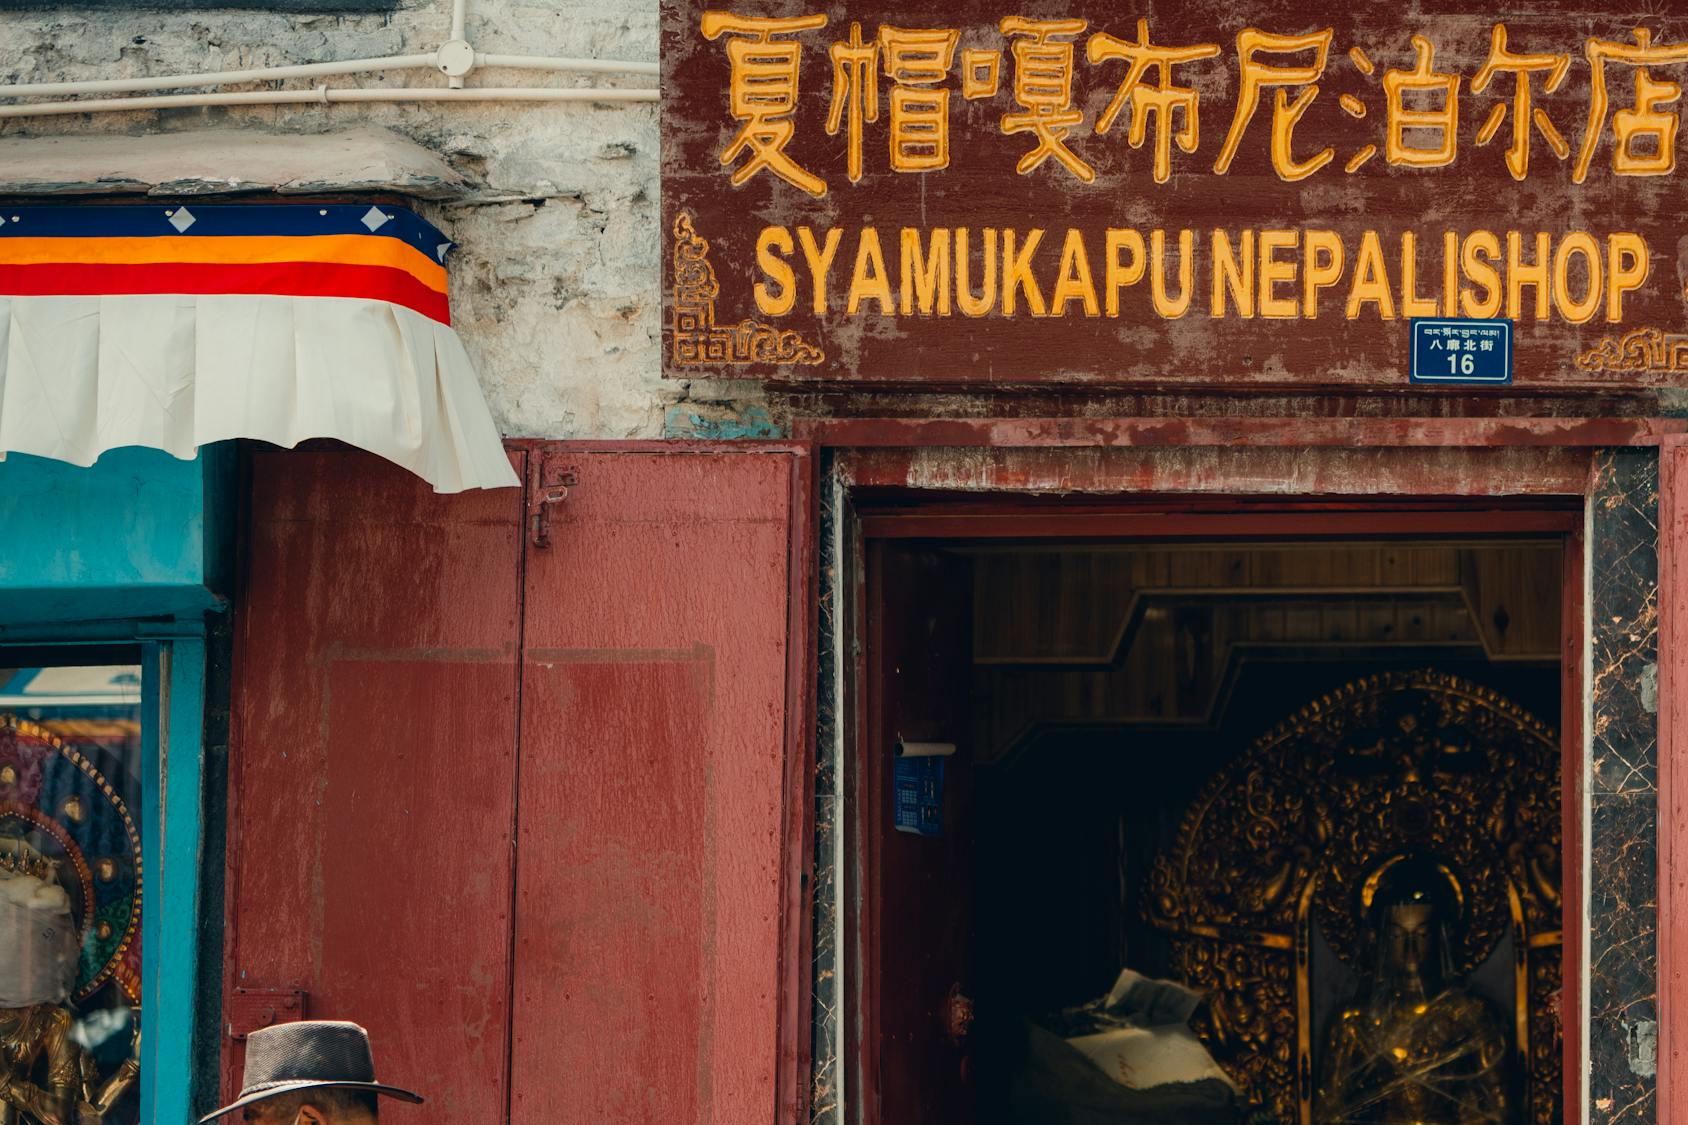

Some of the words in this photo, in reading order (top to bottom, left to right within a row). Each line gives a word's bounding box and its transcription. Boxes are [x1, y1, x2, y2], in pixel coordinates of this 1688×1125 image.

[753, 225, 1195, 320] SYAMUKAPU
[1429, 339, 1494, 352] 八廓北街
[1447, 353, 1475, 375] 16
